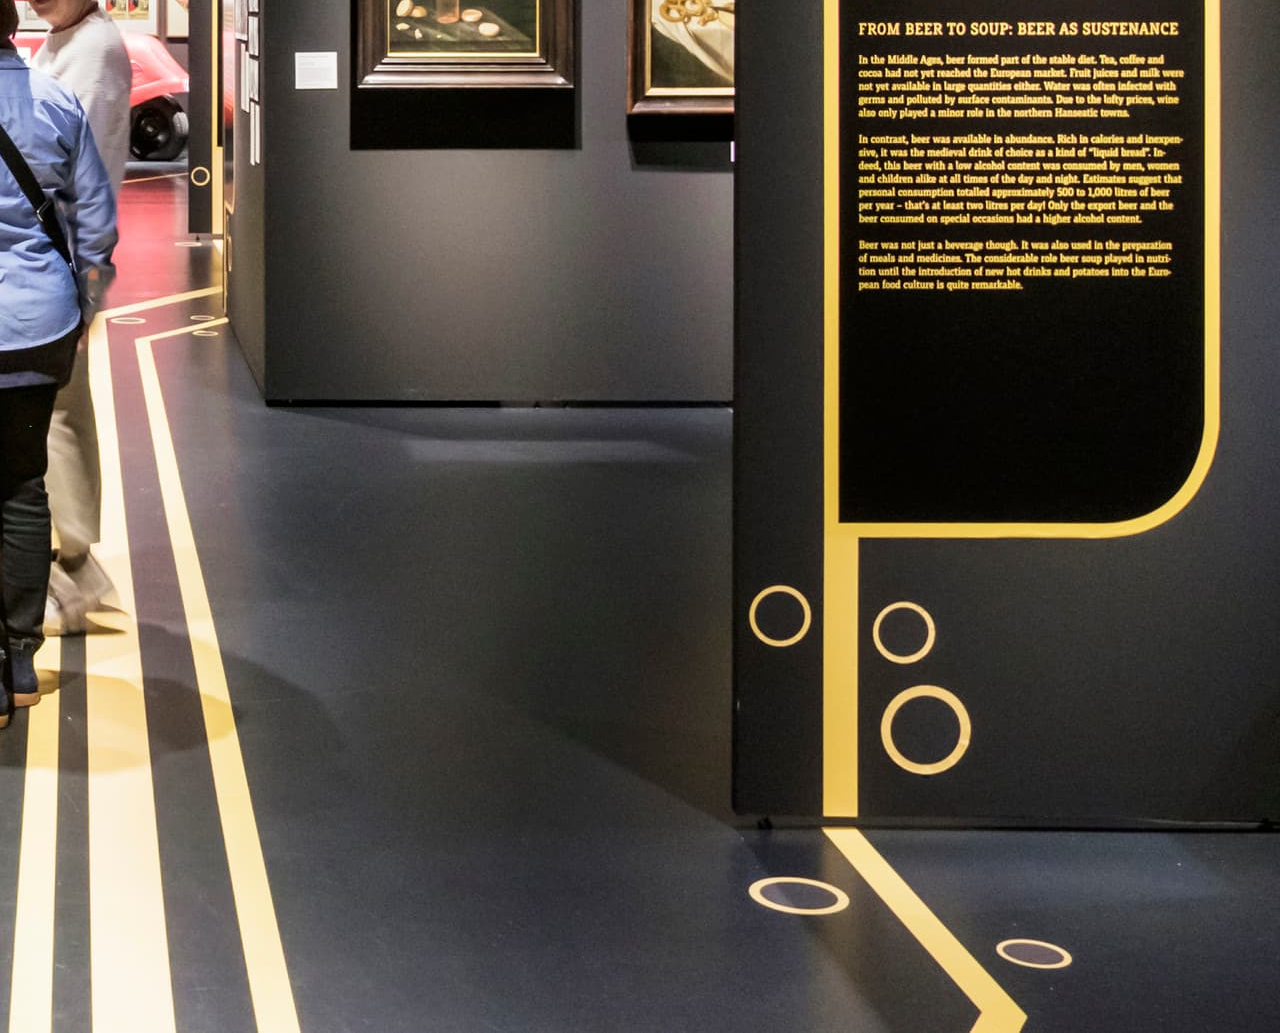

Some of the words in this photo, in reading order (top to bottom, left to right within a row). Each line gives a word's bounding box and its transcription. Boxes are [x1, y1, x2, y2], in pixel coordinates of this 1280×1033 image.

[859, 23, 900, 35] FROM
[905, 22, 943, 35] BEER
[946, 22, 966, 35] TO
[970, 22, 1013, 35] SOUP:
[1017, 22, 1056, 35] BEER
[1059, 22, 1078, 35] AS
[1082, 22, 1179, 35] SUSTENANCE
[859, 55, 868, 64] In
[870, 55, 885, 64] the
[888, 55, 918, 64] Middle
[946, 55, 965, 64] beer
[967, 54, 999, 64] formed
[1000, 56, 1020, 66] part
[1021, 54, 1031, 64] of
[1032, 54, 1048, 64] the
[1119, 54, 1146, 64] coffee
[1147, 55, 1165, 64] and
[885, 68, 902, 77] had
[903, 69, 919, 77] not
[920, 70, 935, 79] yet
[937, 68, 972, 78] reached
[973, 68, 988, 77] the
[990, 68, 1032, 79] European
[1033, 68, 1067, 77] market.
[1069, 68, 1092, 78] Fruit
[1093, 68, 1119, 79] juices
[1120, 68, 1138, 77] and
[1139, 68, 1160, 77] milk
[875, 83, 889, 92] yet
[891, 81, 931, 91] available
[932, 82, 942, 91] in
[944, 81, 966, 93] large
[967, 81, 1012, 93] quantities
[1043, 81, 1071, 91] Water
[1072, 83, 1091, 91] was
[1092, 81, 1116, 91] often
[1155, 81, 1177, 91] with
[888, 95, 905, 104] and
[906, 94, 942, 106] polluted
[944, 94, 956, 106] by
[991, 95, 1053, 104] contaminants.
[1056, 94, 1074, 104] Due
[1075, 96, 1085, 104] to
[1087, 94, 1102, 104] the
[1103, 94, 1124, 106] lofty
[1126, 95, 1155, 106] prices,
[1157, 95, 1179, 104] wine
[858, 108, 876, 117] also
[878, 108, 897, 119] only
[899, 108, 928, 119] played
[938, 108, 965, 117] minor
[966, 108, 984, 117] role
[985, 108, 995, 117] in
[997, 108, 1012, 117] the
[1014, 108, 1053, 117] northern
[859, 187, 896, 198] personal
[898, 188, 955, 198] consumption
[956, 187, 990, 197] totalled
[992, 187, 1055, 199] approximately
[1057, 187, 1075, 197] 500
[1076, 189, 1086, 197] to
[1088, 187, 1113, 198] 1,000
[1114, 187, 1138, 197] litres
[1139, 187, 1149, 197] of
[1150, 187, 1170, 197] beer
[859, 214, 878, 223] beer
[880, 214, 924, 223] consumed
[940, 214, 970, 225] special
[972, 214, 1014, 223] occasions
[1016, 214, 1033, 223] had
[1043, 214, 1071, 225] higher
[1073, 214, 1105, 223] alcohol
[1106, 215, 1142, 223] content.
[878, 267, 899, 276] until
[902, 267, 916, 276] the
[918, 267, 972, 276] introduction
[974, 266, 983, 276] of
[1006, 267, 1021, 276] hot
[1023, 266, 1052, 276] drinks
[1053, 267, 1071, 276] and
[1072, 268, 1109, 278] potatoes
[1111, 267, 1129, 276] into
[1131, 267, 1146, 276] the
[859, 282, 880, 290] pean
[882, 280, 901, 289] food
[903, 280, 934, 289] culture
[936, 280, 944, 289] is
[946, 280, 969, 291] quite
